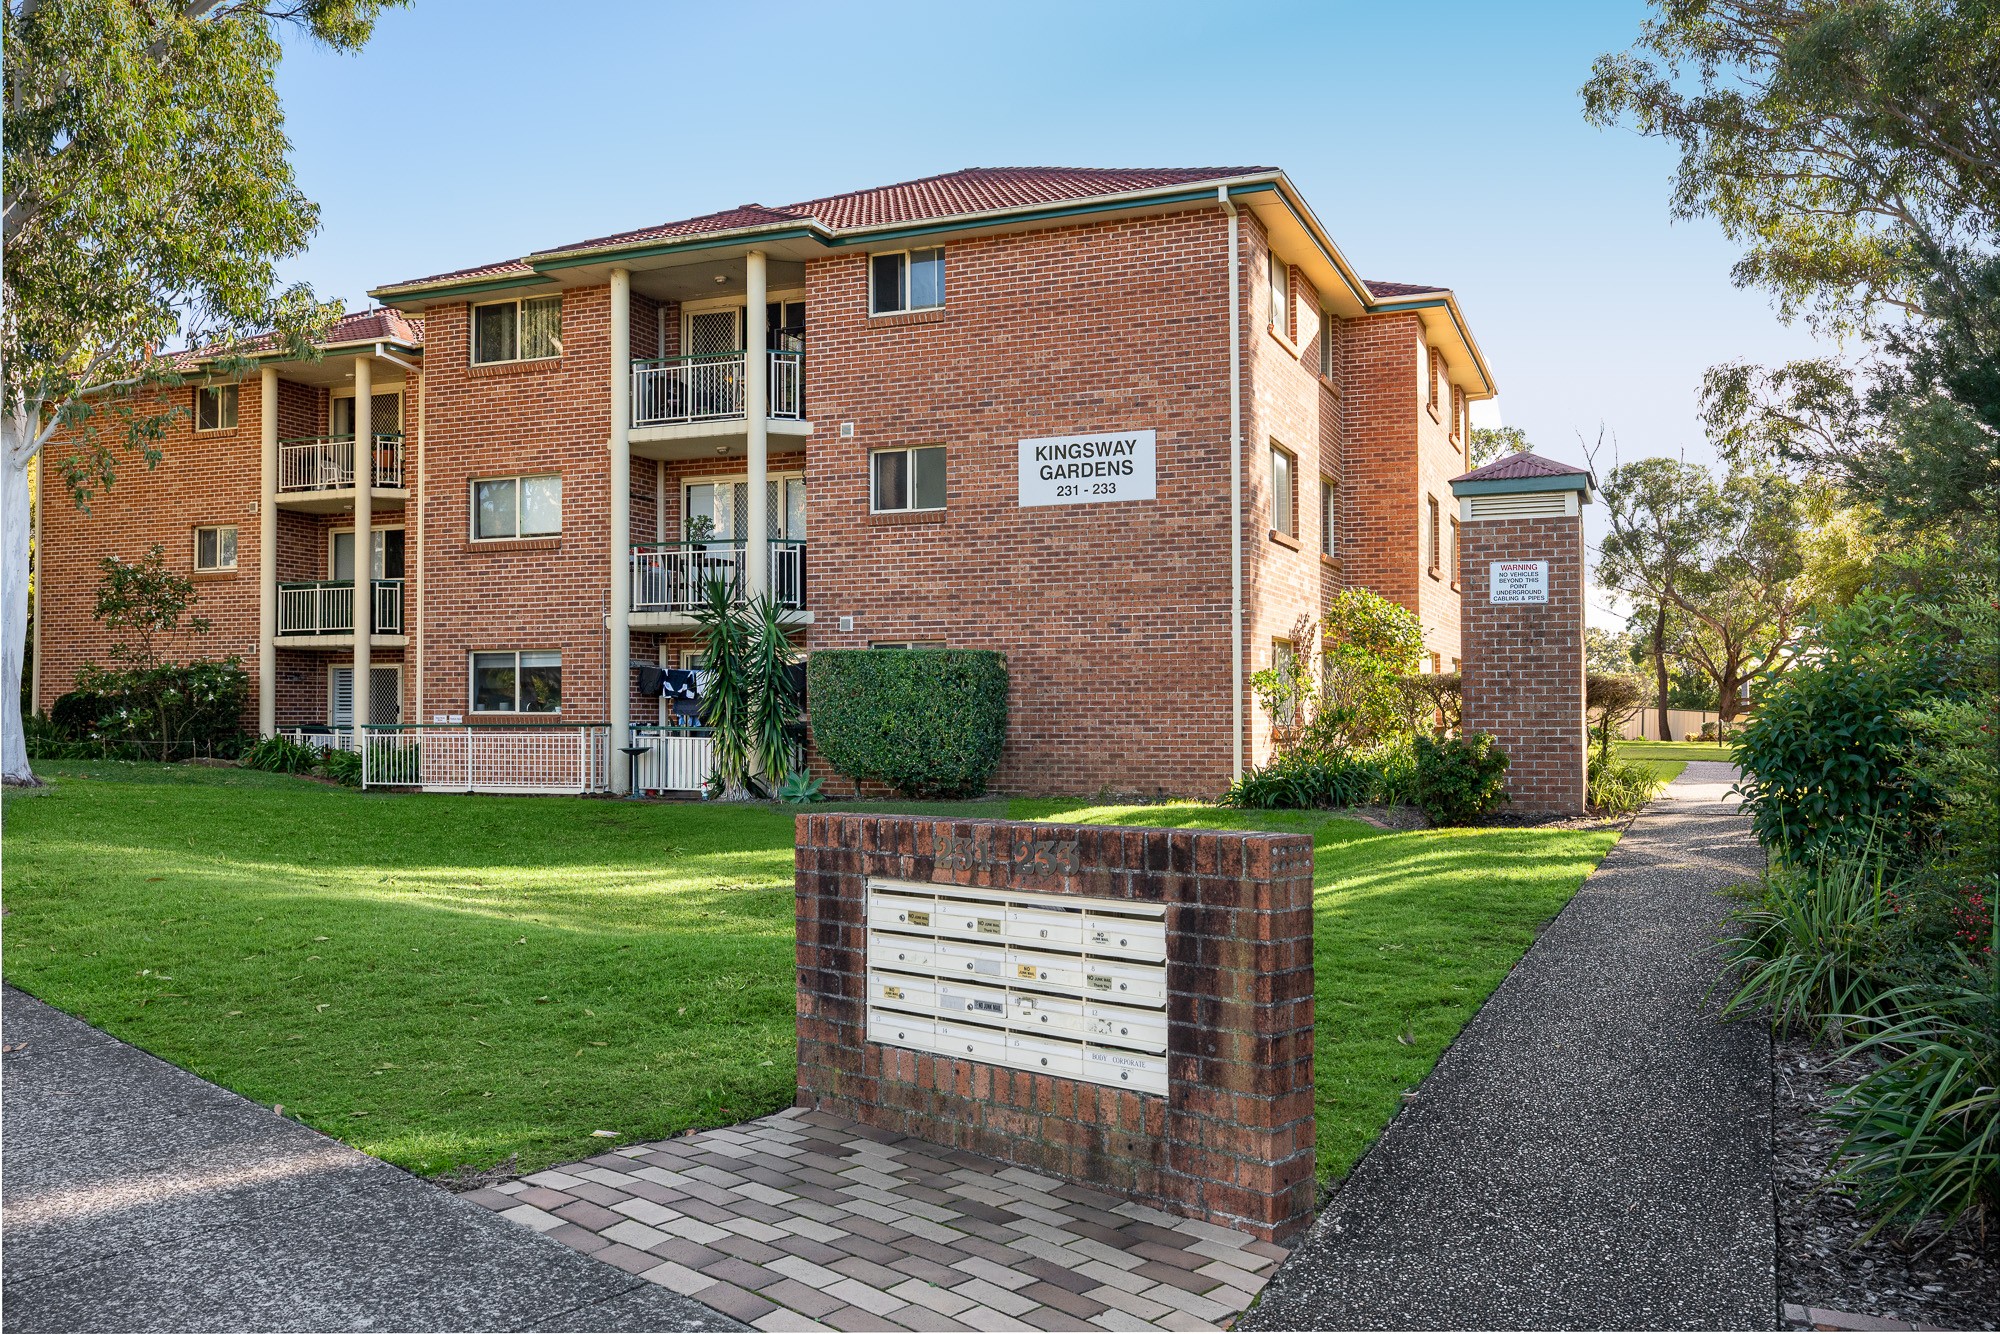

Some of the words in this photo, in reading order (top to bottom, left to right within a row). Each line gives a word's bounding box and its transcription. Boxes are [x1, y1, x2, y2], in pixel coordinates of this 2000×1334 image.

[1035, 439, 1137, 462] KINGSWAY
[1040, 460, 1134, 480] GARDENS
[1056, 485, 1078, 496] 231
[1092, 482, 1116, 494] 233
[933, 835, 991, 872] 231
[1014, 840, 1080, 877] 233
[1092, 1053, 1107, 1061] BODY
[1112, 1056, 1146, 1068] CORPORATE
